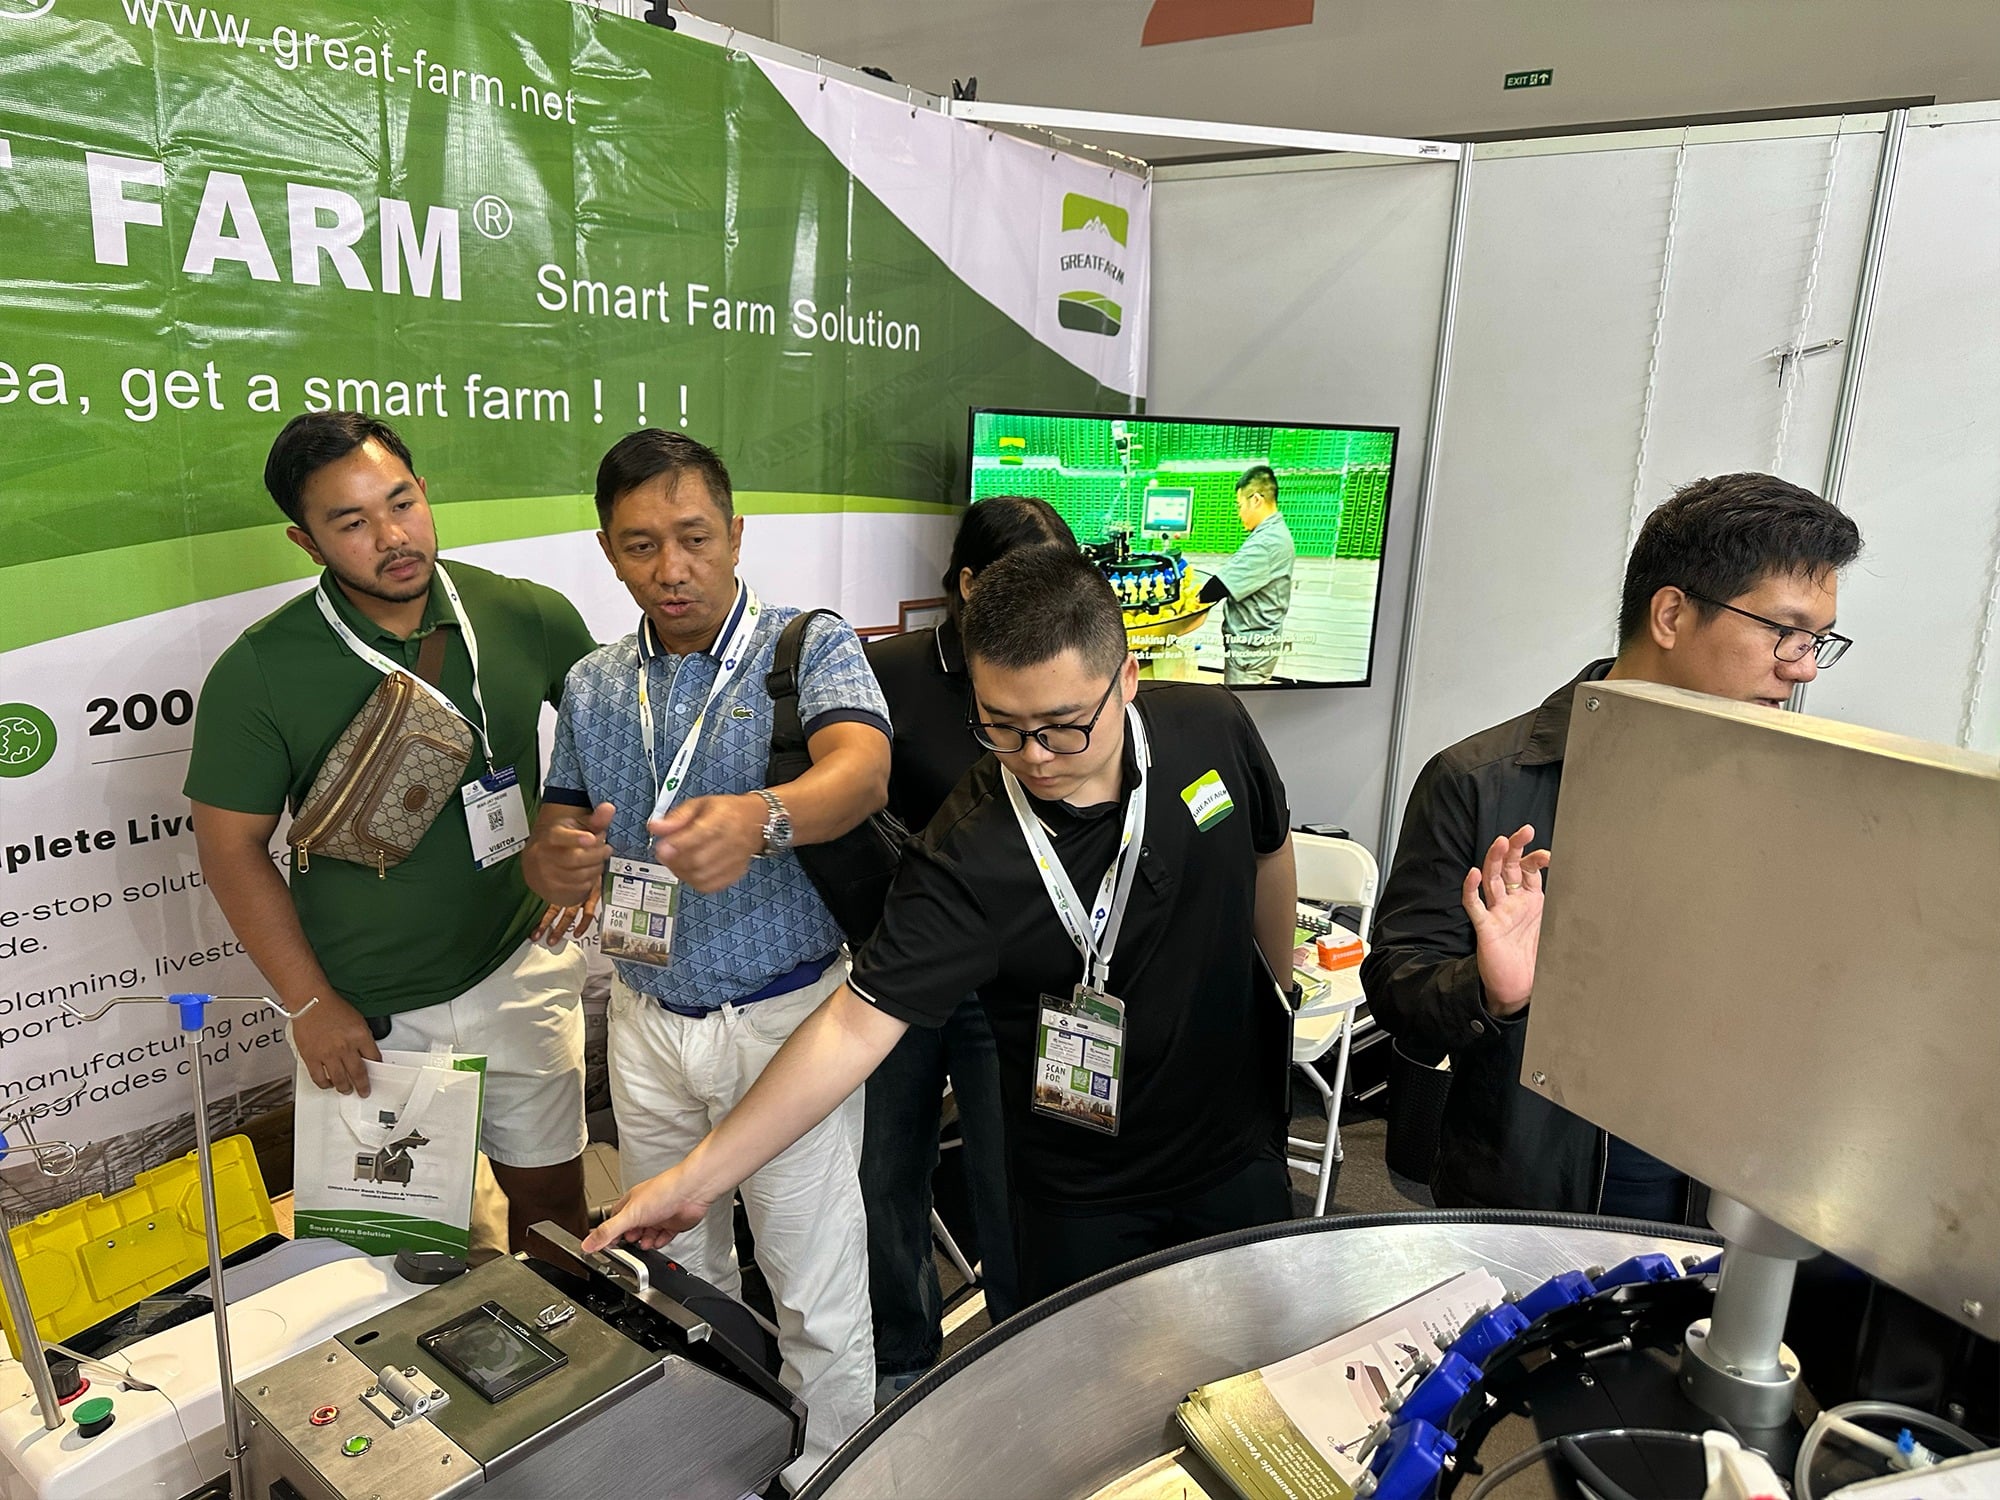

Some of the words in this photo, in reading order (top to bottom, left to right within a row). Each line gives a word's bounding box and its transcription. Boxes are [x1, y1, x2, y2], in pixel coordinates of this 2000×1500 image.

[120, 0, 577, 125] www.great-farm.net
[1507, 76, 1528, 86] EXIT
[86, 151, 462, 302] FARM
[1060, 253, 1125, 285] GREATFARM
[536, 263, 670, 323] Smart
[687, 282, 775, 336] Farm
[792, 300, 920, 352] Solution
[120, 360, 225, 422] get
[247, 373, 281, 413] a
[304, 373, 448, 418] smart
[464, 373, 570, 422] farm
[86, 689, 193, 736] 200
[0, 829, 116, 874] plete
[489, 837, 515, 852] VISITOR
[0, 892, 112, 927] e-stop
[611, 910, 628, 919] SCAN
[0, 1018, 232, 1098] manufacturng
[242, 1003, 284, 1027] an
[1046, 1064, 1065, 1075] SCAN
[309, 1224, 333, 1233] Smart
[335, 1227, 355, 1235] Farm
[357, 1229, 391, 1238] Solution
[1224, 1411, 1261, 1460] Vaccinato
[1260, 1460, 1298, 1500] neumatic
